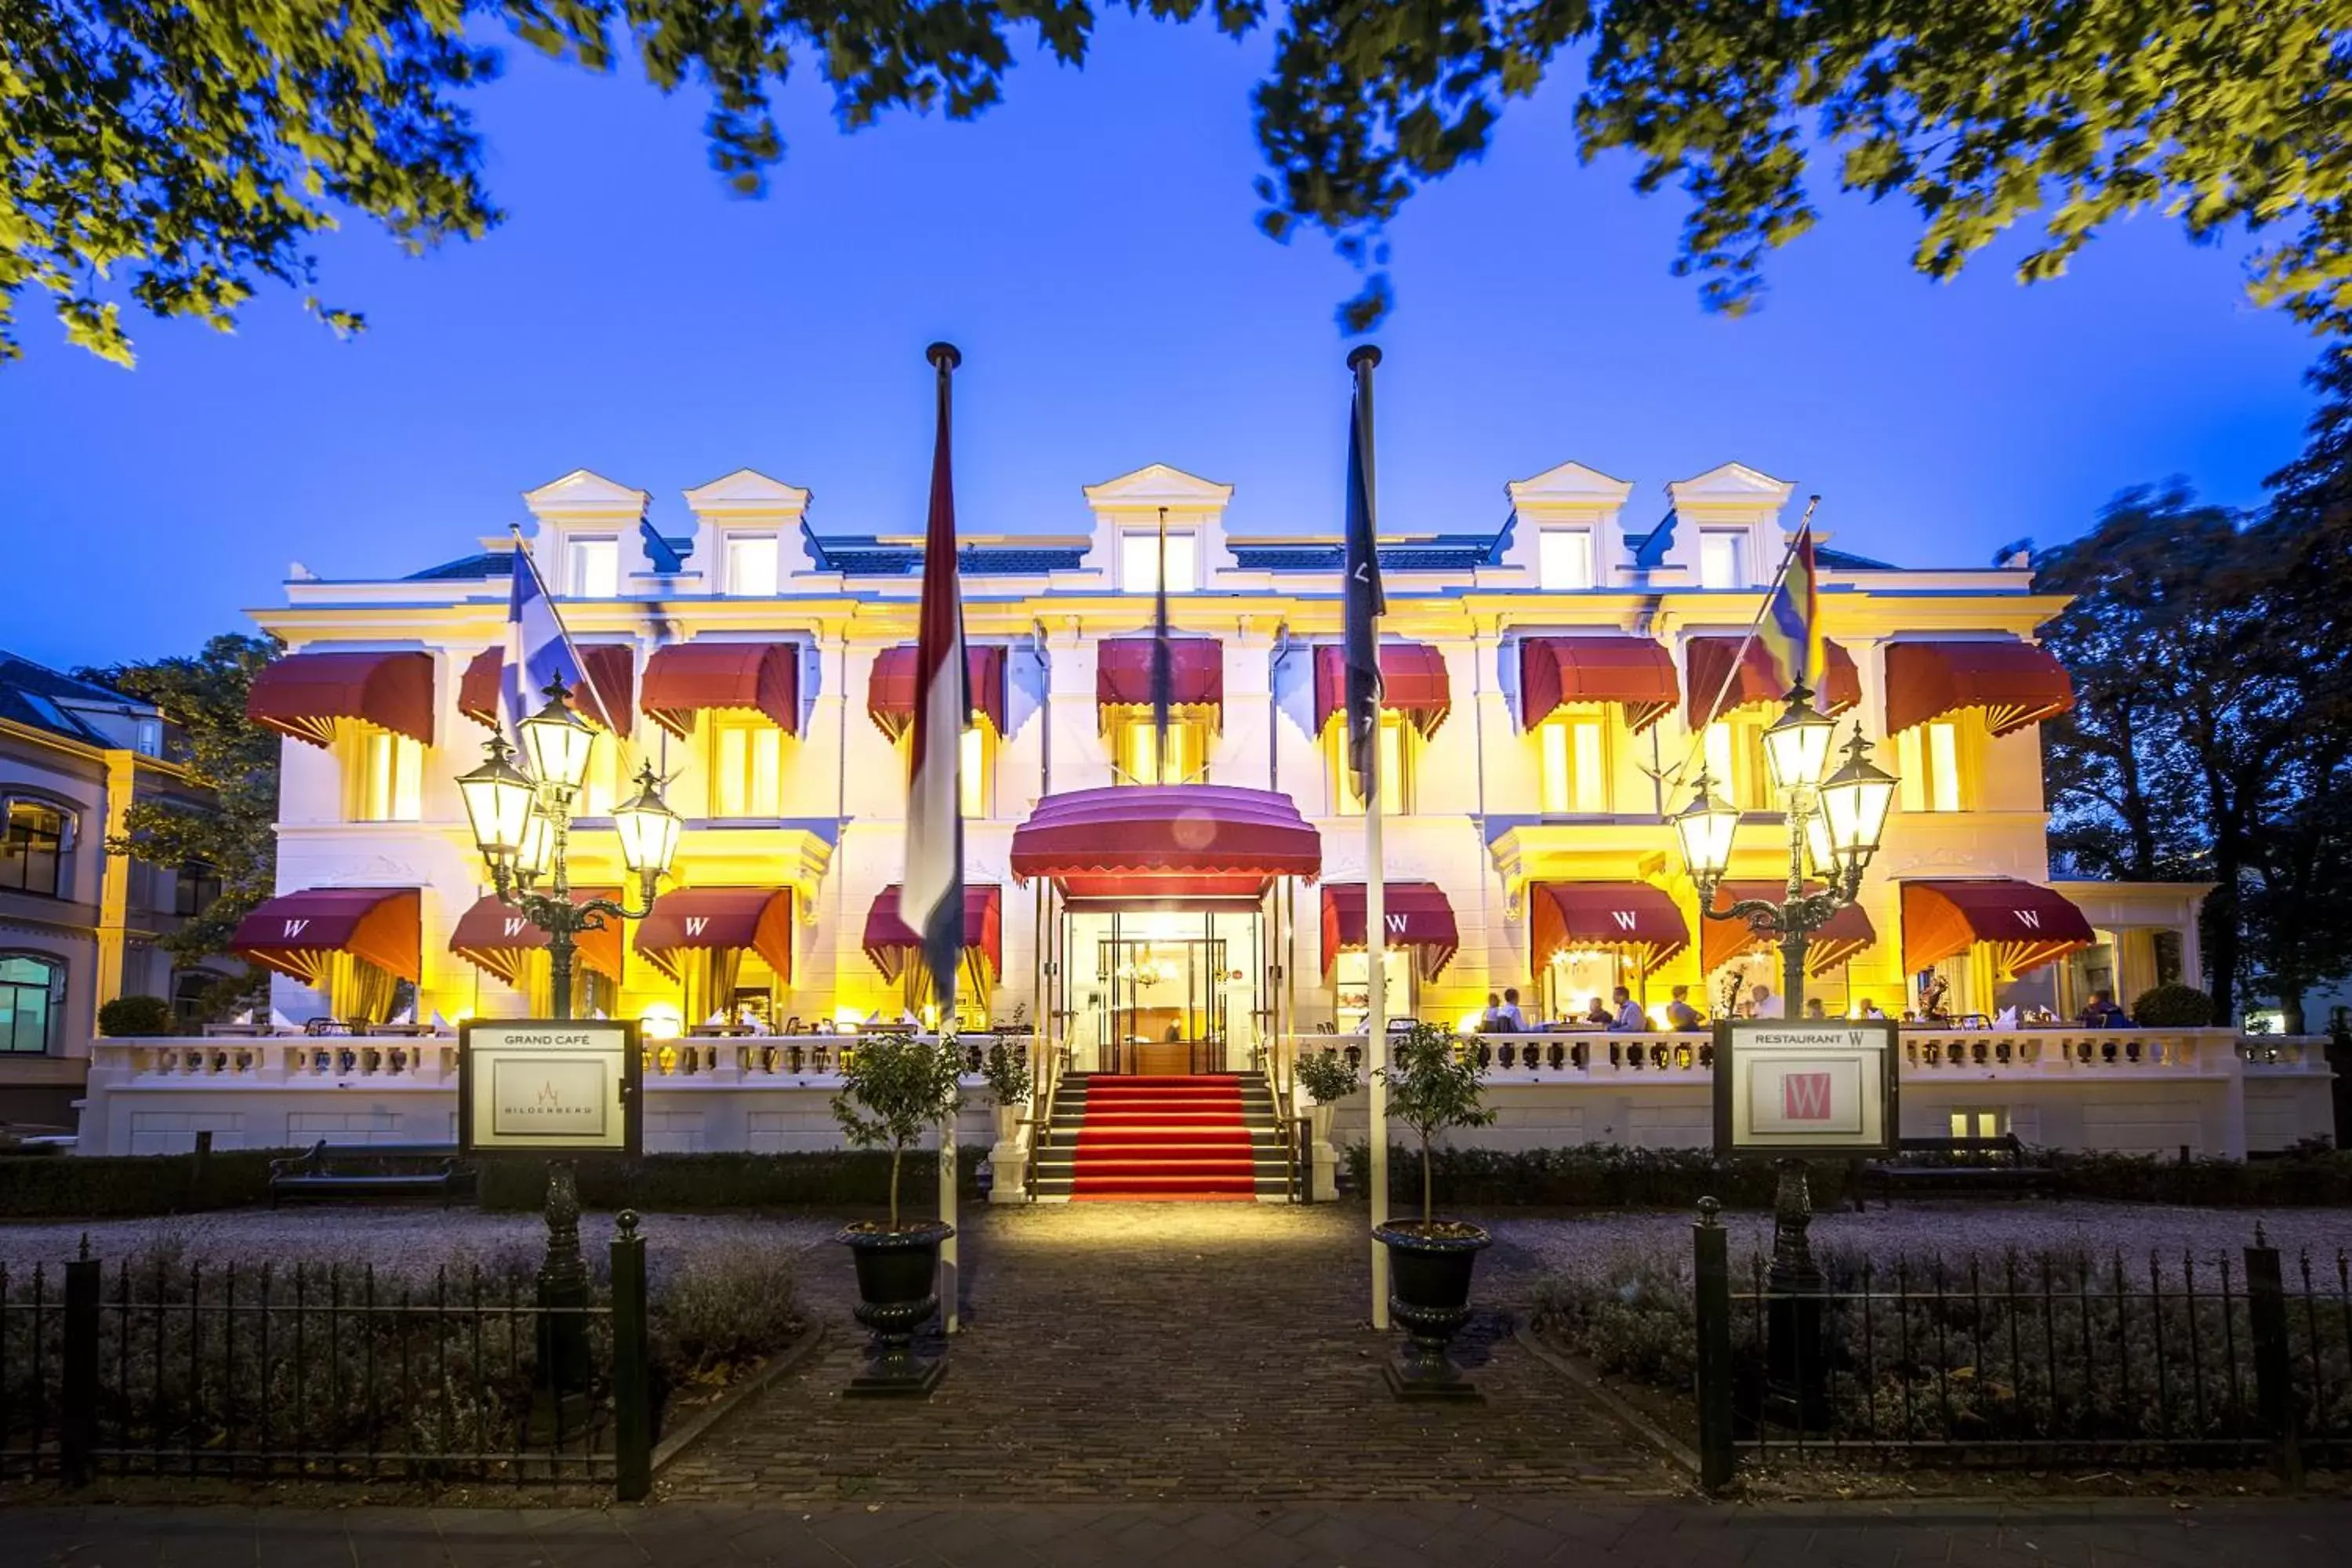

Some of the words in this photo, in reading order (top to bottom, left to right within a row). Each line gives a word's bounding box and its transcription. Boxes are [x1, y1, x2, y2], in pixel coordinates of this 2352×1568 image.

[504, 917, 526, 936] W
[686, 916, 710, 936] W
[1385, 914, 1407, 933] W
[1612, 911, 1635, 931] W
[2013, 910, 2040, 928] W
[284, 920, 309, 938] W
[505, 1036, 552, 1045] GRAND
[1755, 1034, 1842, 1044] RESTAURANT
[1849, 1032, 1864, 1046] W
[1787, 1074, 1828, 1117] W
